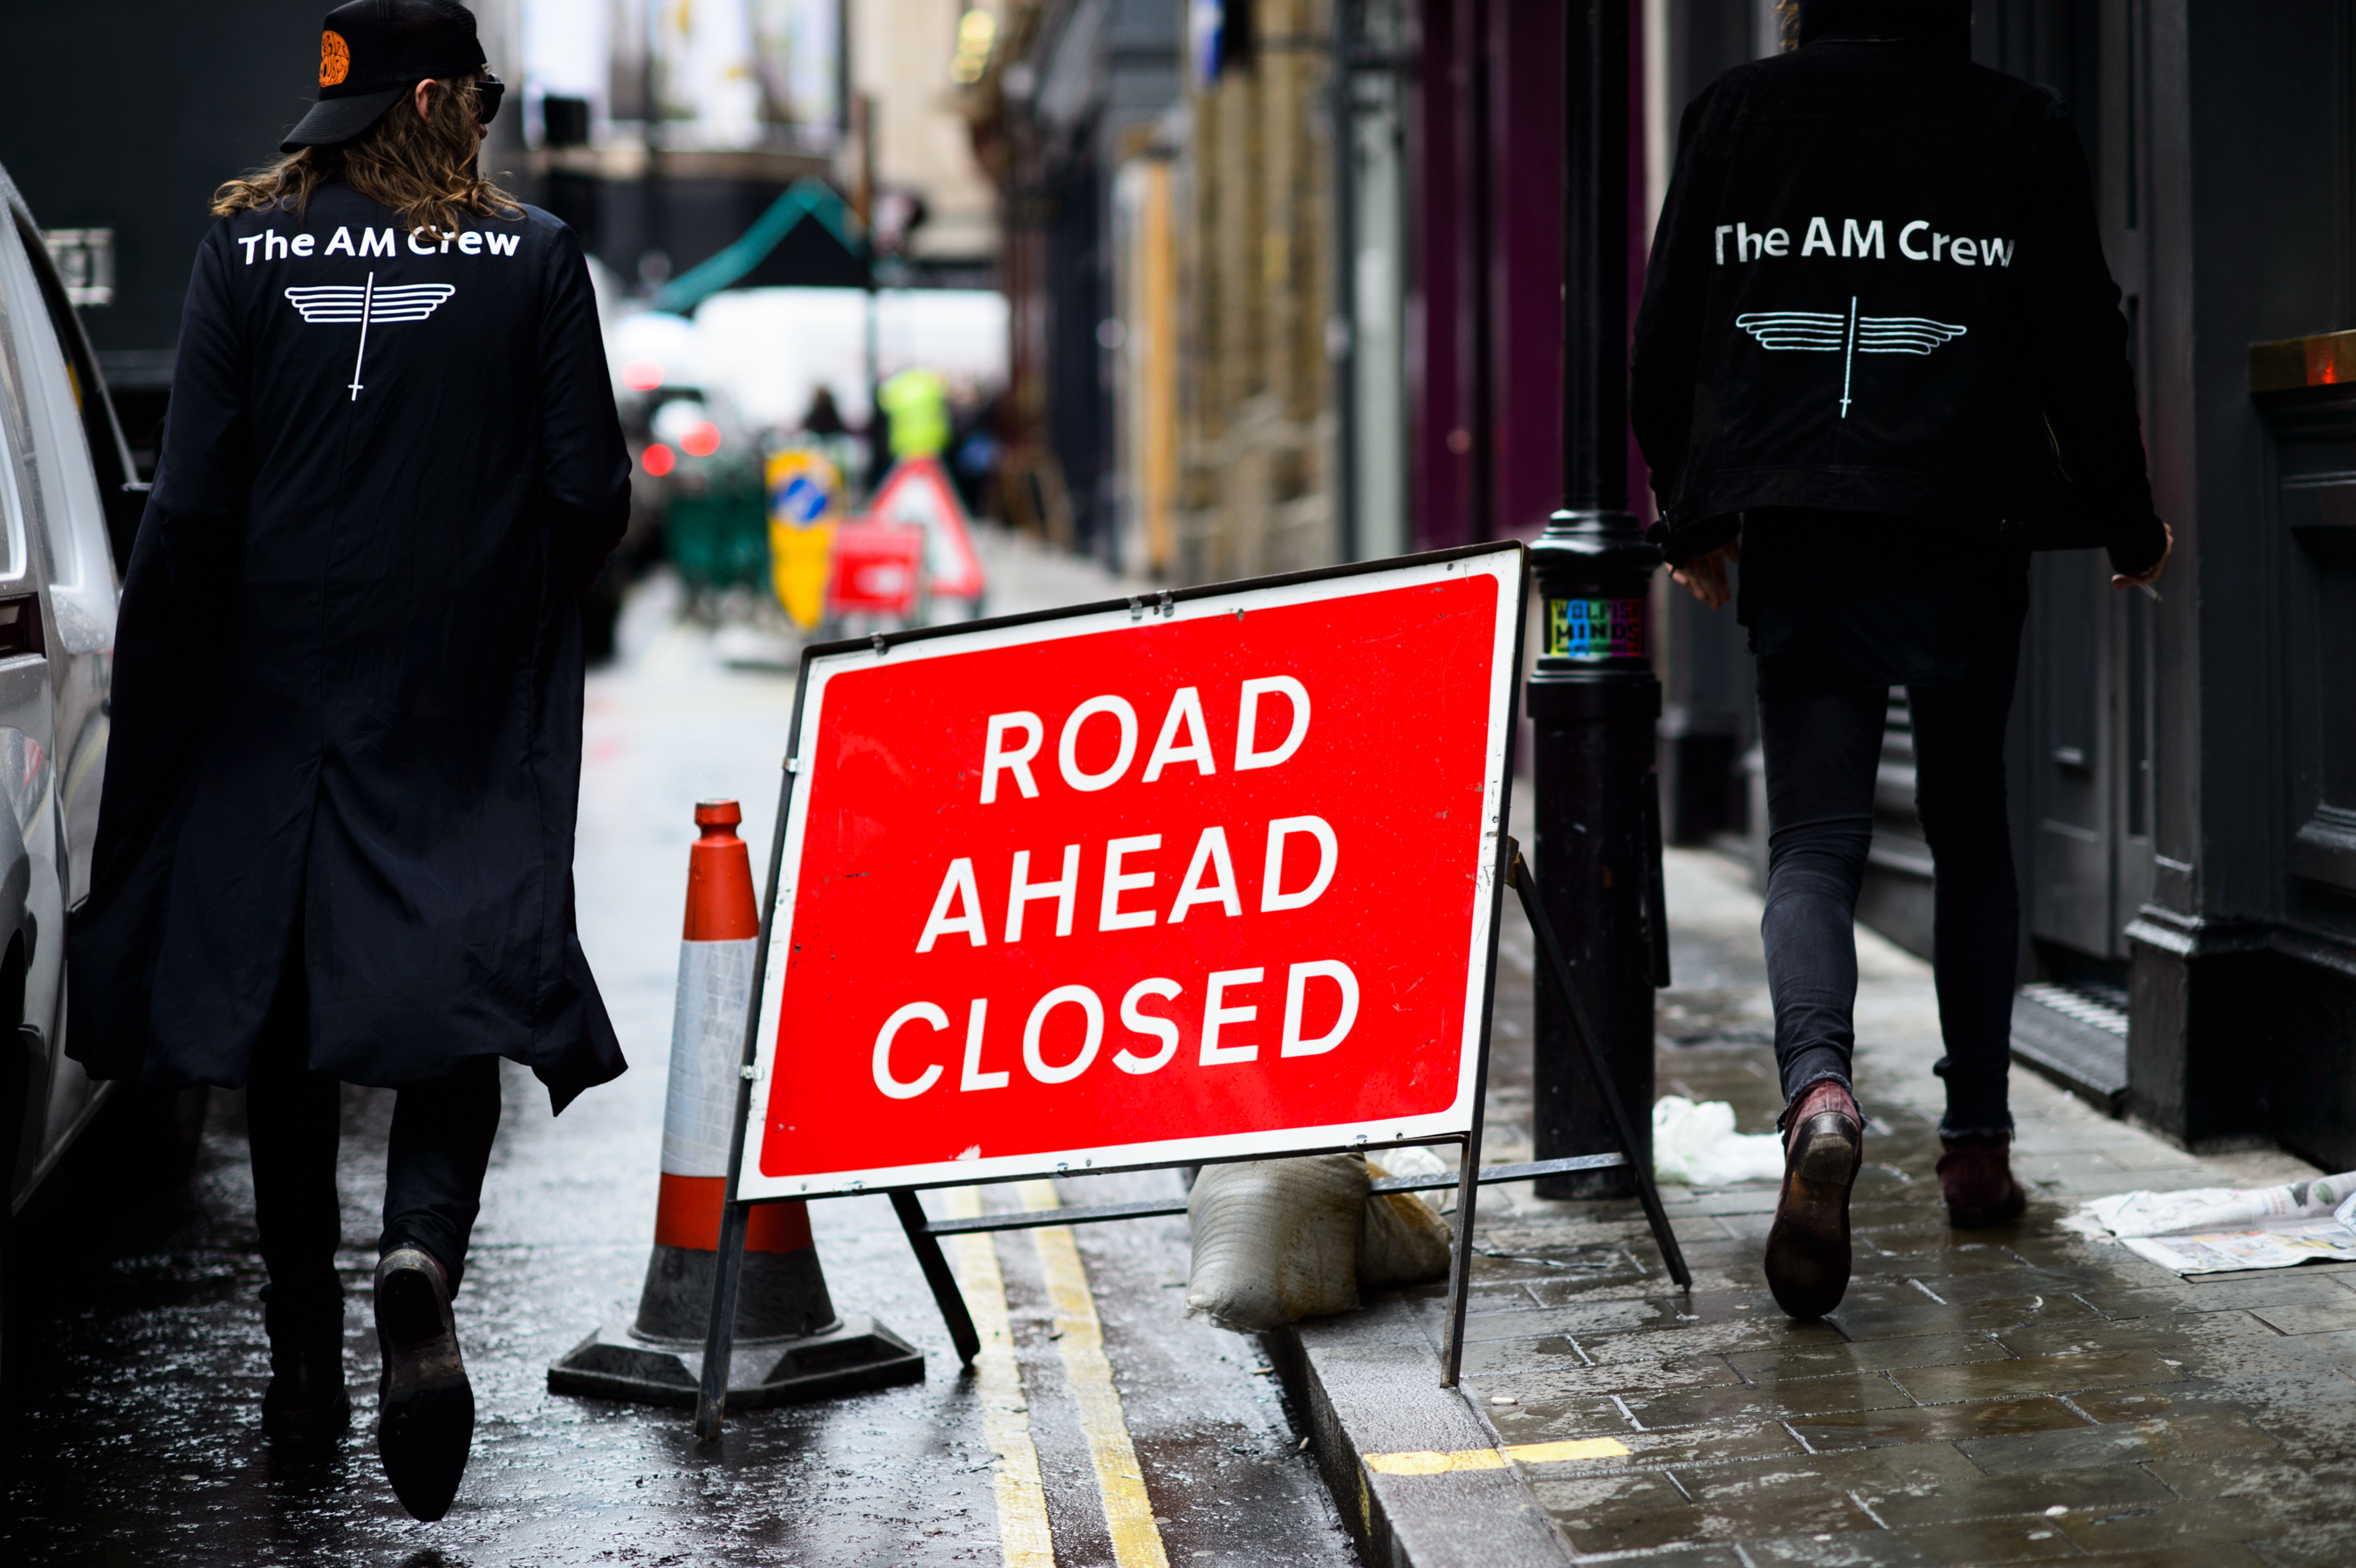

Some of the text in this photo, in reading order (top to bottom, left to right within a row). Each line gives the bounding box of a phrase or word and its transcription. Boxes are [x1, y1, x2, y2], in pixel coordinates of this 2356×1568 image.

[237, 225, 521, 265] The AM Crew
[1715, 216, 2015, 267] The AM Crew
[1556, 623, 1640, 644] MINDS
[979, 674, 1312, 805] ROAD
[914, 814, 1339, 954] AHEAD
[872, 959, 1359, 1099] CLOSED
